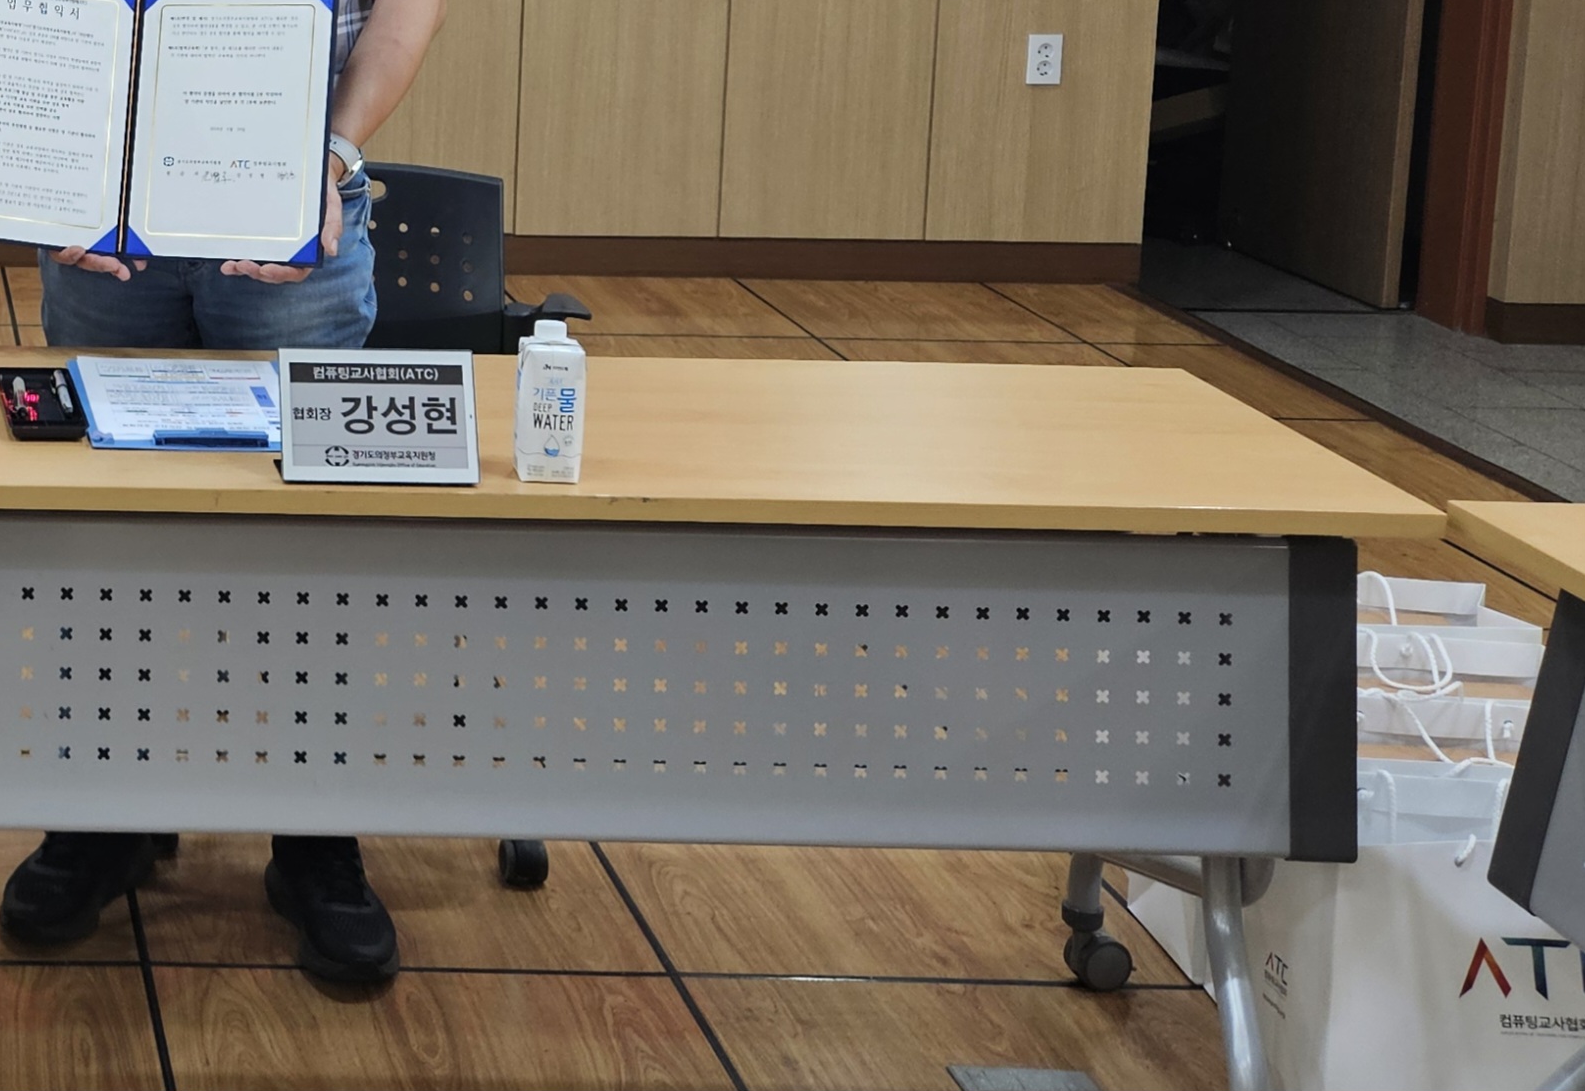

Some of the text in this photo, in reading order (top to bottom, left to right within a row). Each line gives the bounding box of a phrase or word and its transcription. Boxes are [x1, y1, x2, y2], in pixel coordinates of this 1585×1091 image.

[230, 160, 251, 169] ATC
[313, 366, 439, 381] 컴퓨팅교사협회(ATC)
[292, 407, 332, 420] 협회장
[341, 395, 458, 435] 강성현
[532, 402, 553, 413] DEEP
[532, 413, 574, 431] WATER
[352, 449, 436, 462] 경기도의정부교육지원청
[1265, 952, 1290, 986] ATC
[1458, 937, 1585, 1000] AT
